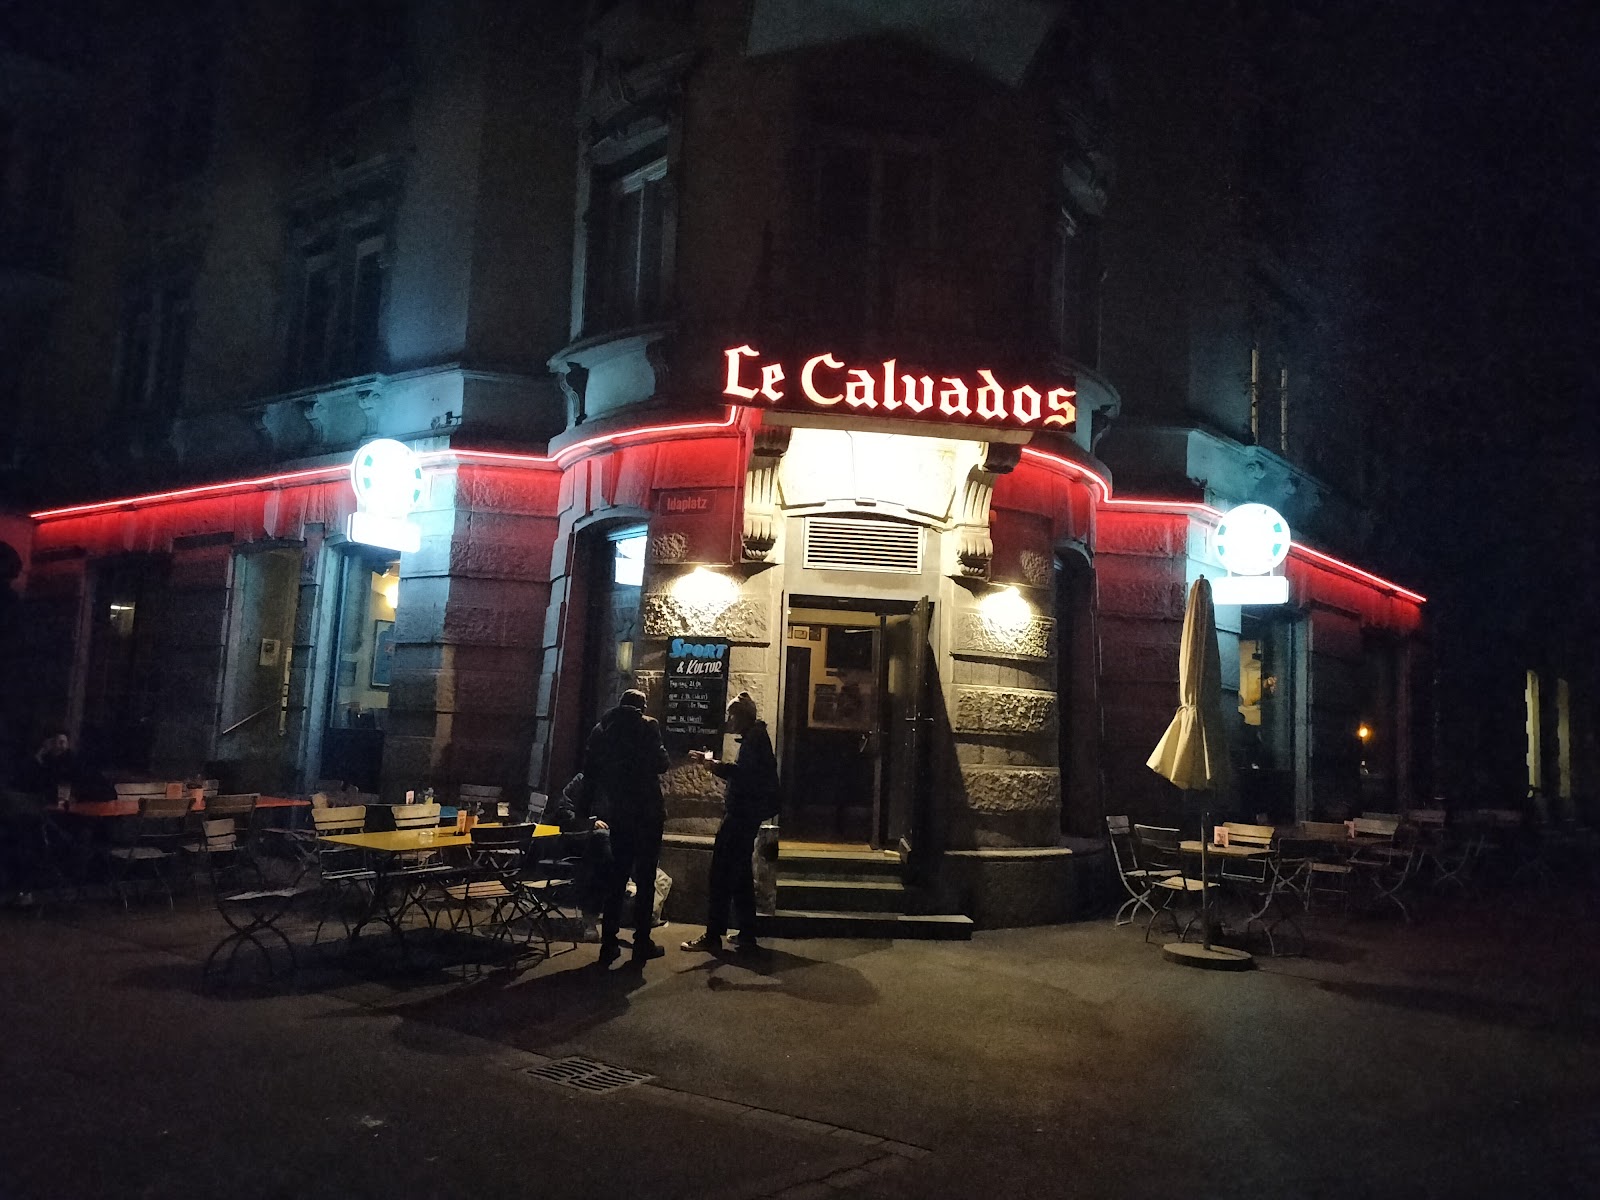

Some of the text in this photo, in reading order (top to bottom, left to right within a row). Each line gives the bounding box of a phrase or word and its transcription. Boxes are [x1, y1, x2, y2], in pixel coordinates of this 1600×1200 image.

[722, 344, 1076, 426] Le Calvados
[667, 496, 708, 512] Idaplatz
[676, 662, 685, 673] &
